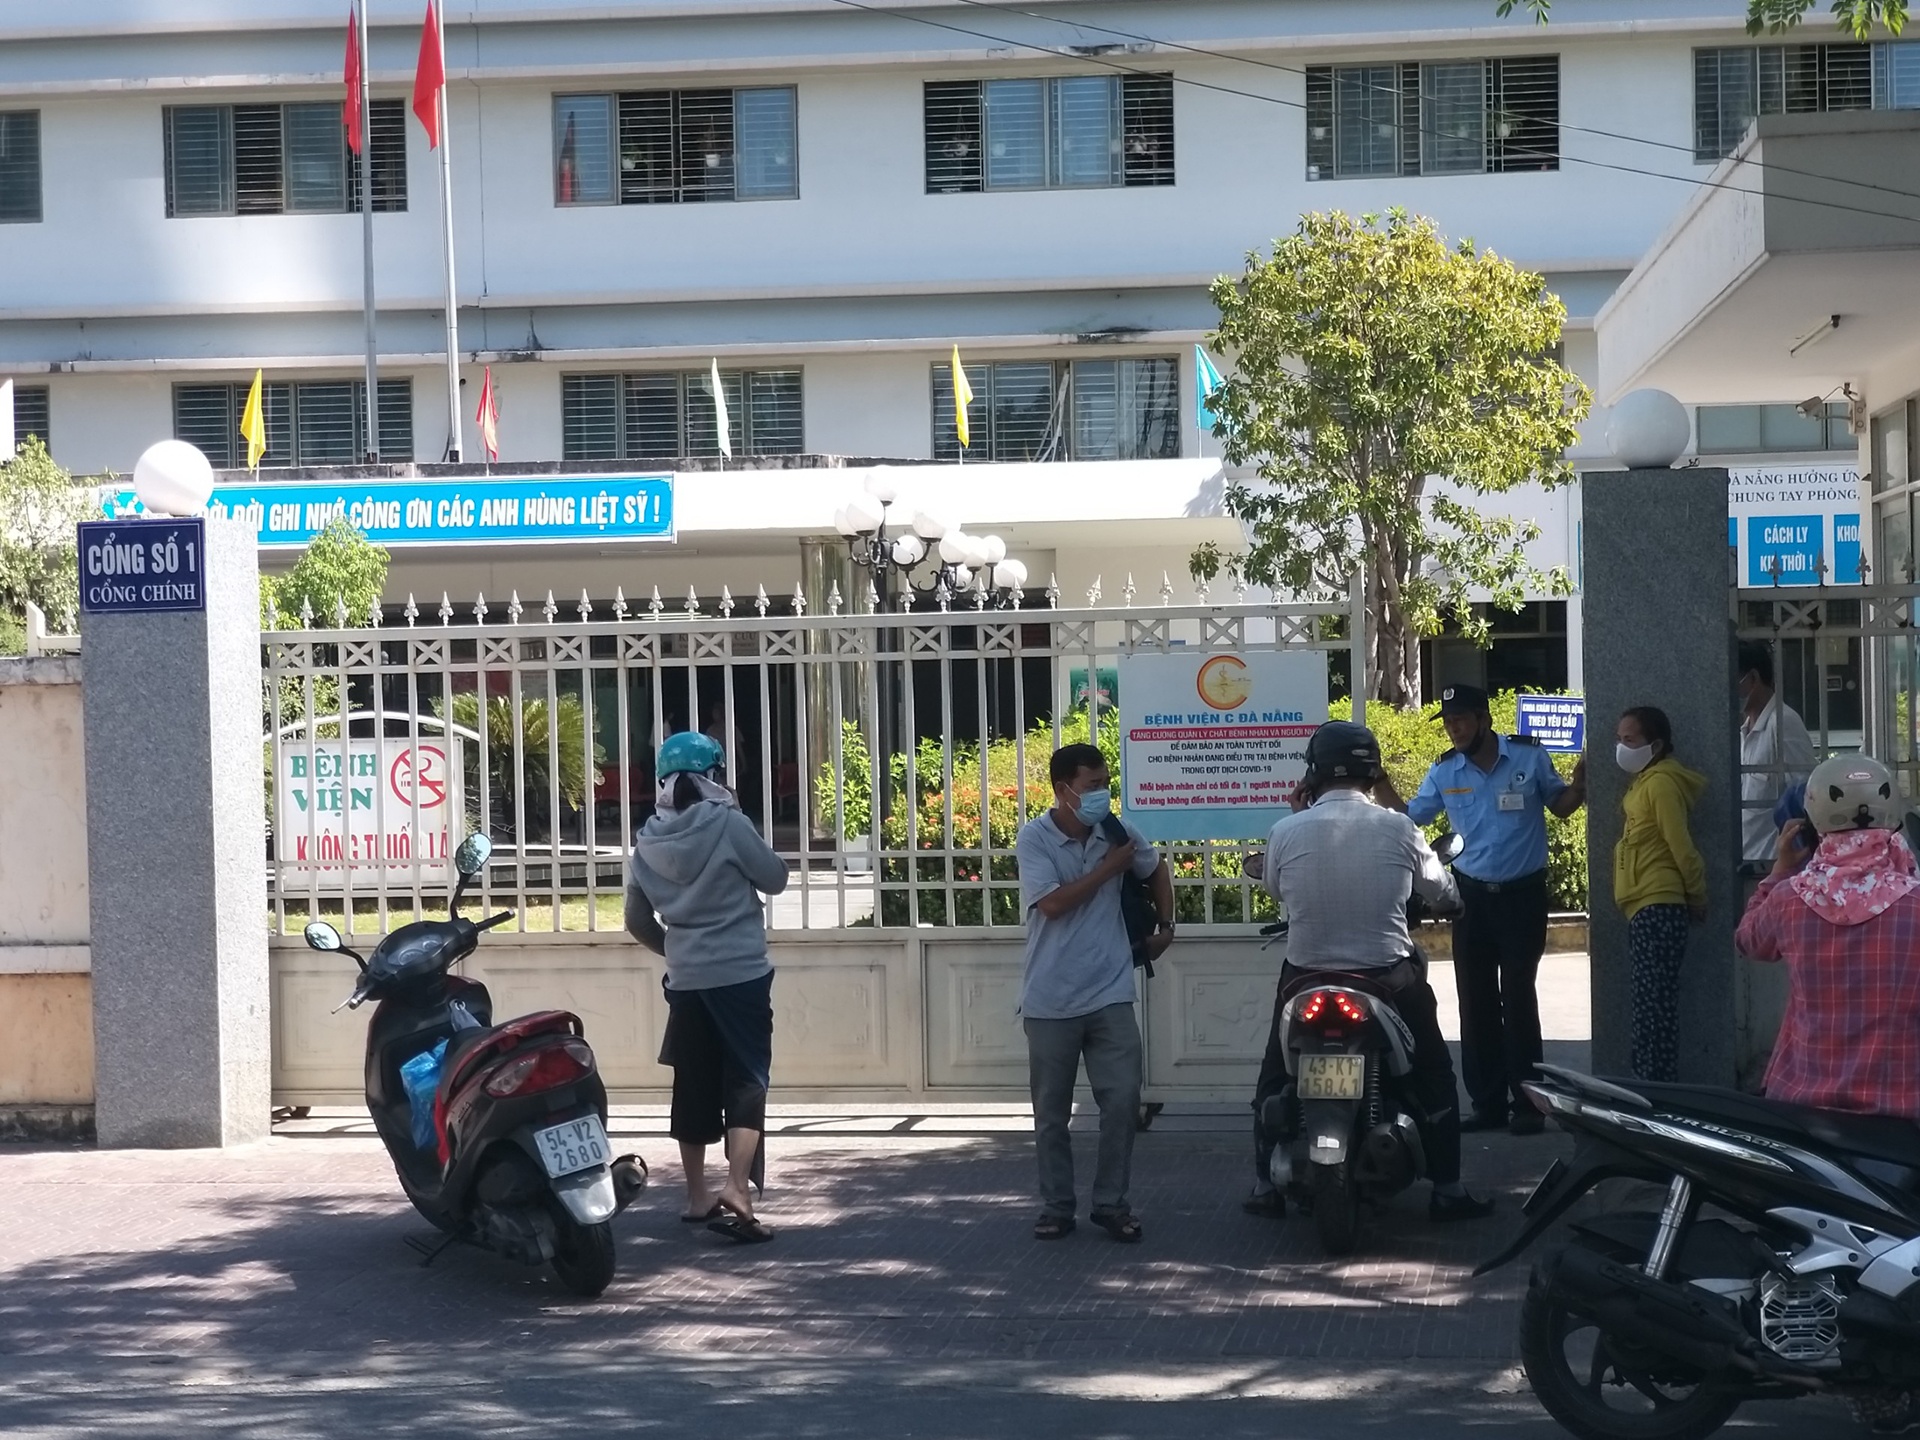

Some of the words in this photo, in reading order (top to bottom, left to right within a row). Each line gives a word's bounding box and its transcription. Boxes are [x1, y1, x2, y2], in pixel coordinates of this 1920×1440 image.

[1744, 469, 1784, 486] NẴNG
[1788, 469, 1838, 484] HƯỞNG
[1842, 469, 1860, 483] ỨN
[1779, 490, 1803, 502] TAY
[269, 503, 299, 532] GHI
[305, 497, 346, 531] NHỚ
[351, 496, 400, 530] CÔNG
[406, 497, 432, 528] ƠN
[437, 494, 475, 528] CÁC
[479, 498, 518, 527] ANH
[524, 491, 575, 526] HÙNG
[580, 490, 620, 530] LIỆT
[624, 489, 648, 524] SỸ
[653, 495, 660, 523] !
[1764, 523, 1793, 544] CÁCH
[1797, 526, 1808, 543] LY
[1837, 525, 1860, 542] KHO
[88, 532, 145, 576] CỔNG
[152, 531, 178, 574] SỐ
[185, 543, 195, 572] 1
[1781, 551, 1805, 572] THỜI
[89, 578, 137, 604] CỔNG
[141, 579, 196, 602] CHÍNH
[1144, 713, 1183, 727] BỆNH
[1187, 712, 1220, 726] VIỆN
[1225, 713, 1234, 723] C
[1238, 711, 1258, 723] ĐÀ
[1528, 714, 1546, 727] THEO
[1547, 714, 1561, 728] YÊU
[291, 747, 376, 784] BỆNH
[1148, 755, 1162, 763] CHO
[1164, 754, 1183, 763] BỆNH
[1184, 754, 1203, 762] NHÂN
[1268, 752, 1287, 761] BỆNH
[1288, 751, 1305, 760] VIỆN
[1222, 766, 1238, 775] DỊCH
[1240, 765, 1272, 773] COVID-19
[1156, 782, 1174, 792] bệnh
[1176, 782, 1194, 790] nhân
[1209, 782, 1218, 790] có
[1250, 781, 1270, 791] người
[1272, 781, 1286, 789] nhà
[292, 781, 373, 817] VIỆN
[1167, 796, 1189, 806] không
[1227, 795, 1248, 805] người
[1250, 794, 1269, 804] bệnh
[1303, 1078, 1358, 1097] 158.41
[545, 1121, 595, 1151] 54-V2
[1702, 1124, 1787, 1150] BLADE
[553, 1141, 602, 1172] 2680
